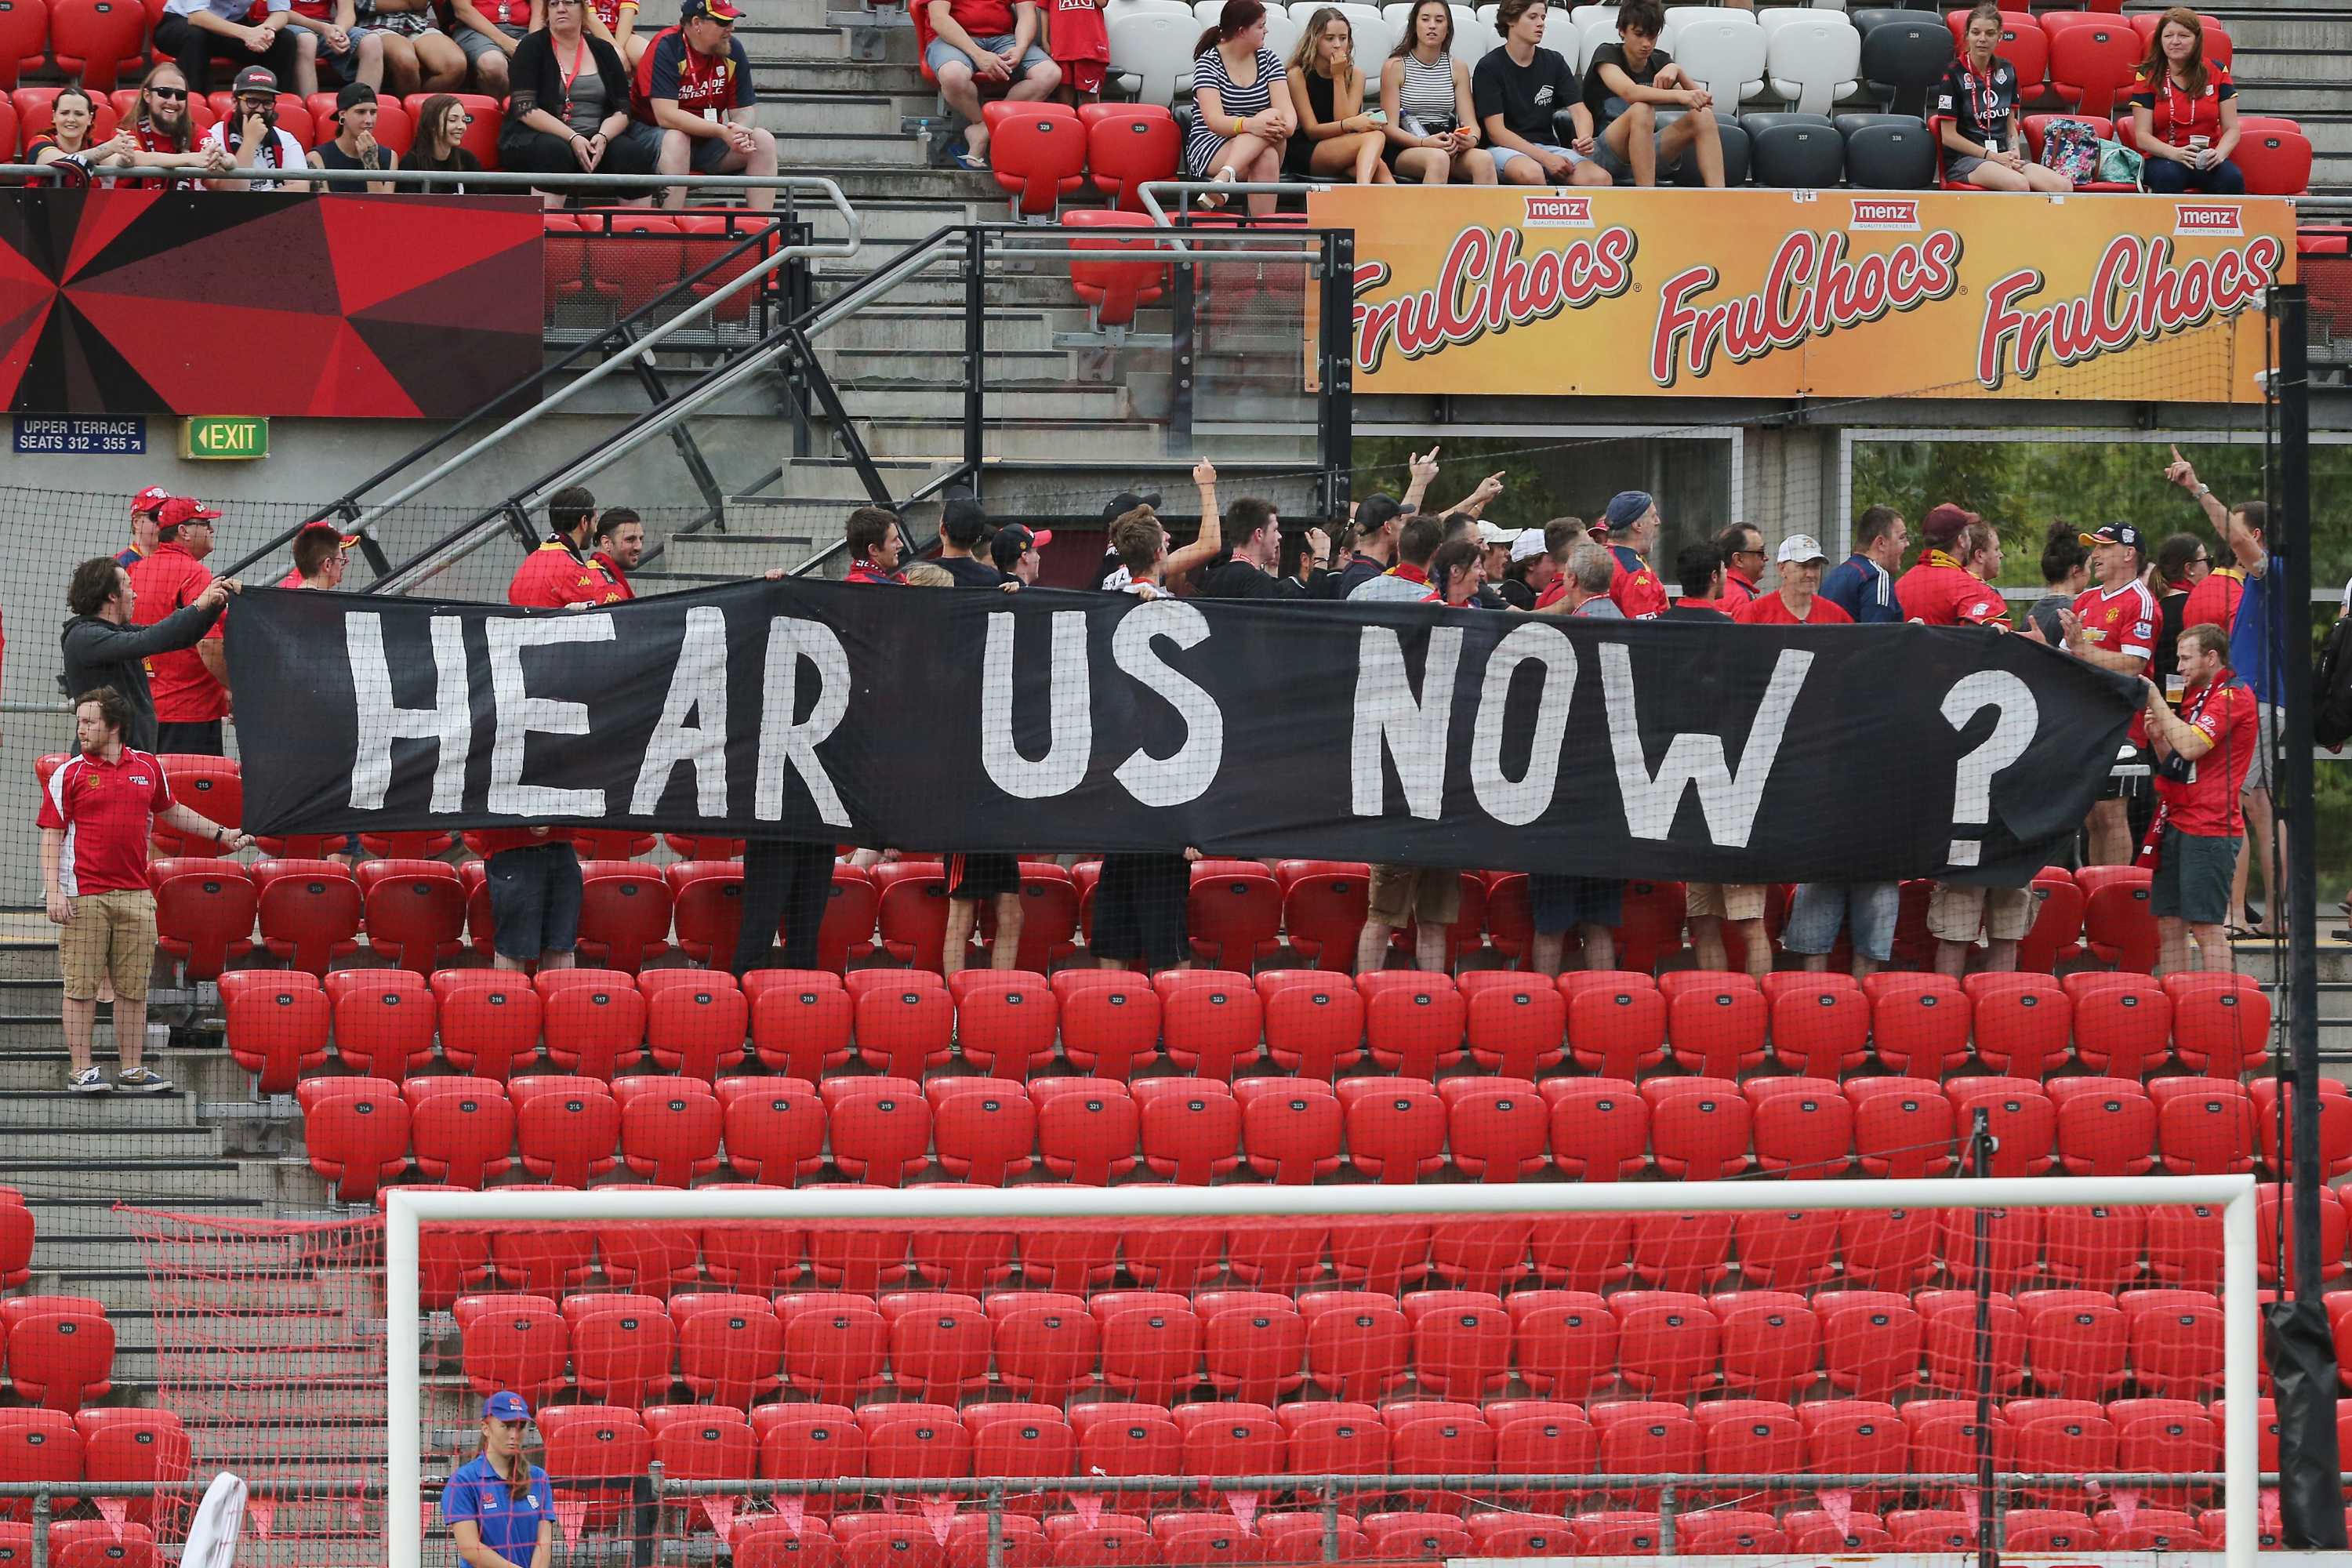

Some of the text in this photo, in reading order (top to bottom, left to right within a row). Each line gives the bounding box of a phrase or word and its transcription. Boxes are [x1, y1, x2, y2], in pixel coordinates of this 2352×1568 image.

[679, 78, 725, 93] ADADE
[1532, 202, 1581, 216] menz
[1860, 205, 1907, 219] menz
[2183, 211, 2230, 224] menz
[1650, 230, 1960, 383] FruChocs
[1976, 234, 2283, 386] FruChocs
[24, 421, 136, 435] UPPER TERRACE
[20, 436, 64, 449] SEATS
[67, 436, 89, 449] 312
[103, 437, 126, 449] 355
[211, 424, 256, 449] EXIT
[345, 600, 2039, 866] HEAR US NOW ?
